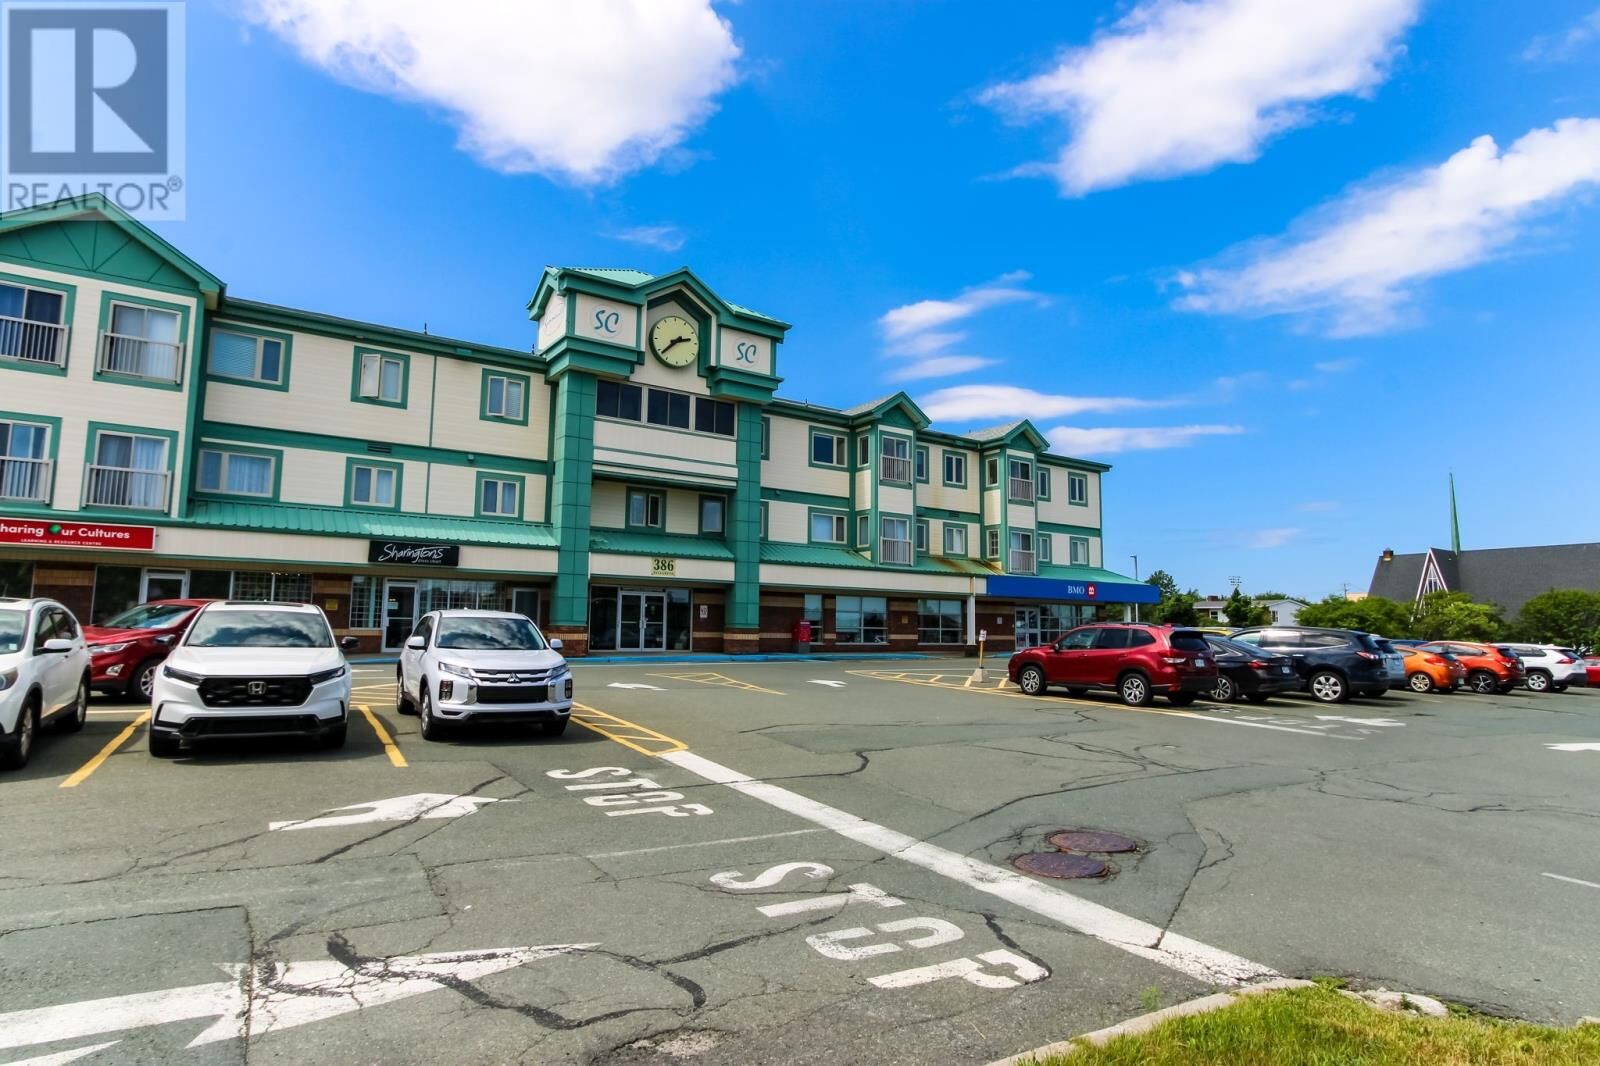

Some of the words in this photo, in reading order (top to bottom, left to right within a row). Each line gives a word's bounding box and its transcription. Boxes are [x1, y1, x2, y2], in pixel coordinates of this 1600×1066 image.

[594, 309, 619, 333] SC
[736, 342, 757, 364] SC
[0, 523, 44, 537] haring
[78, 528, 130, 539] Cultures
[653, 558, 674, 571] 386
[1067, 585, 1085, 595] BMO
[545, 766, 714, 817] STOP
[709, 861, 1049, 990] STOP
